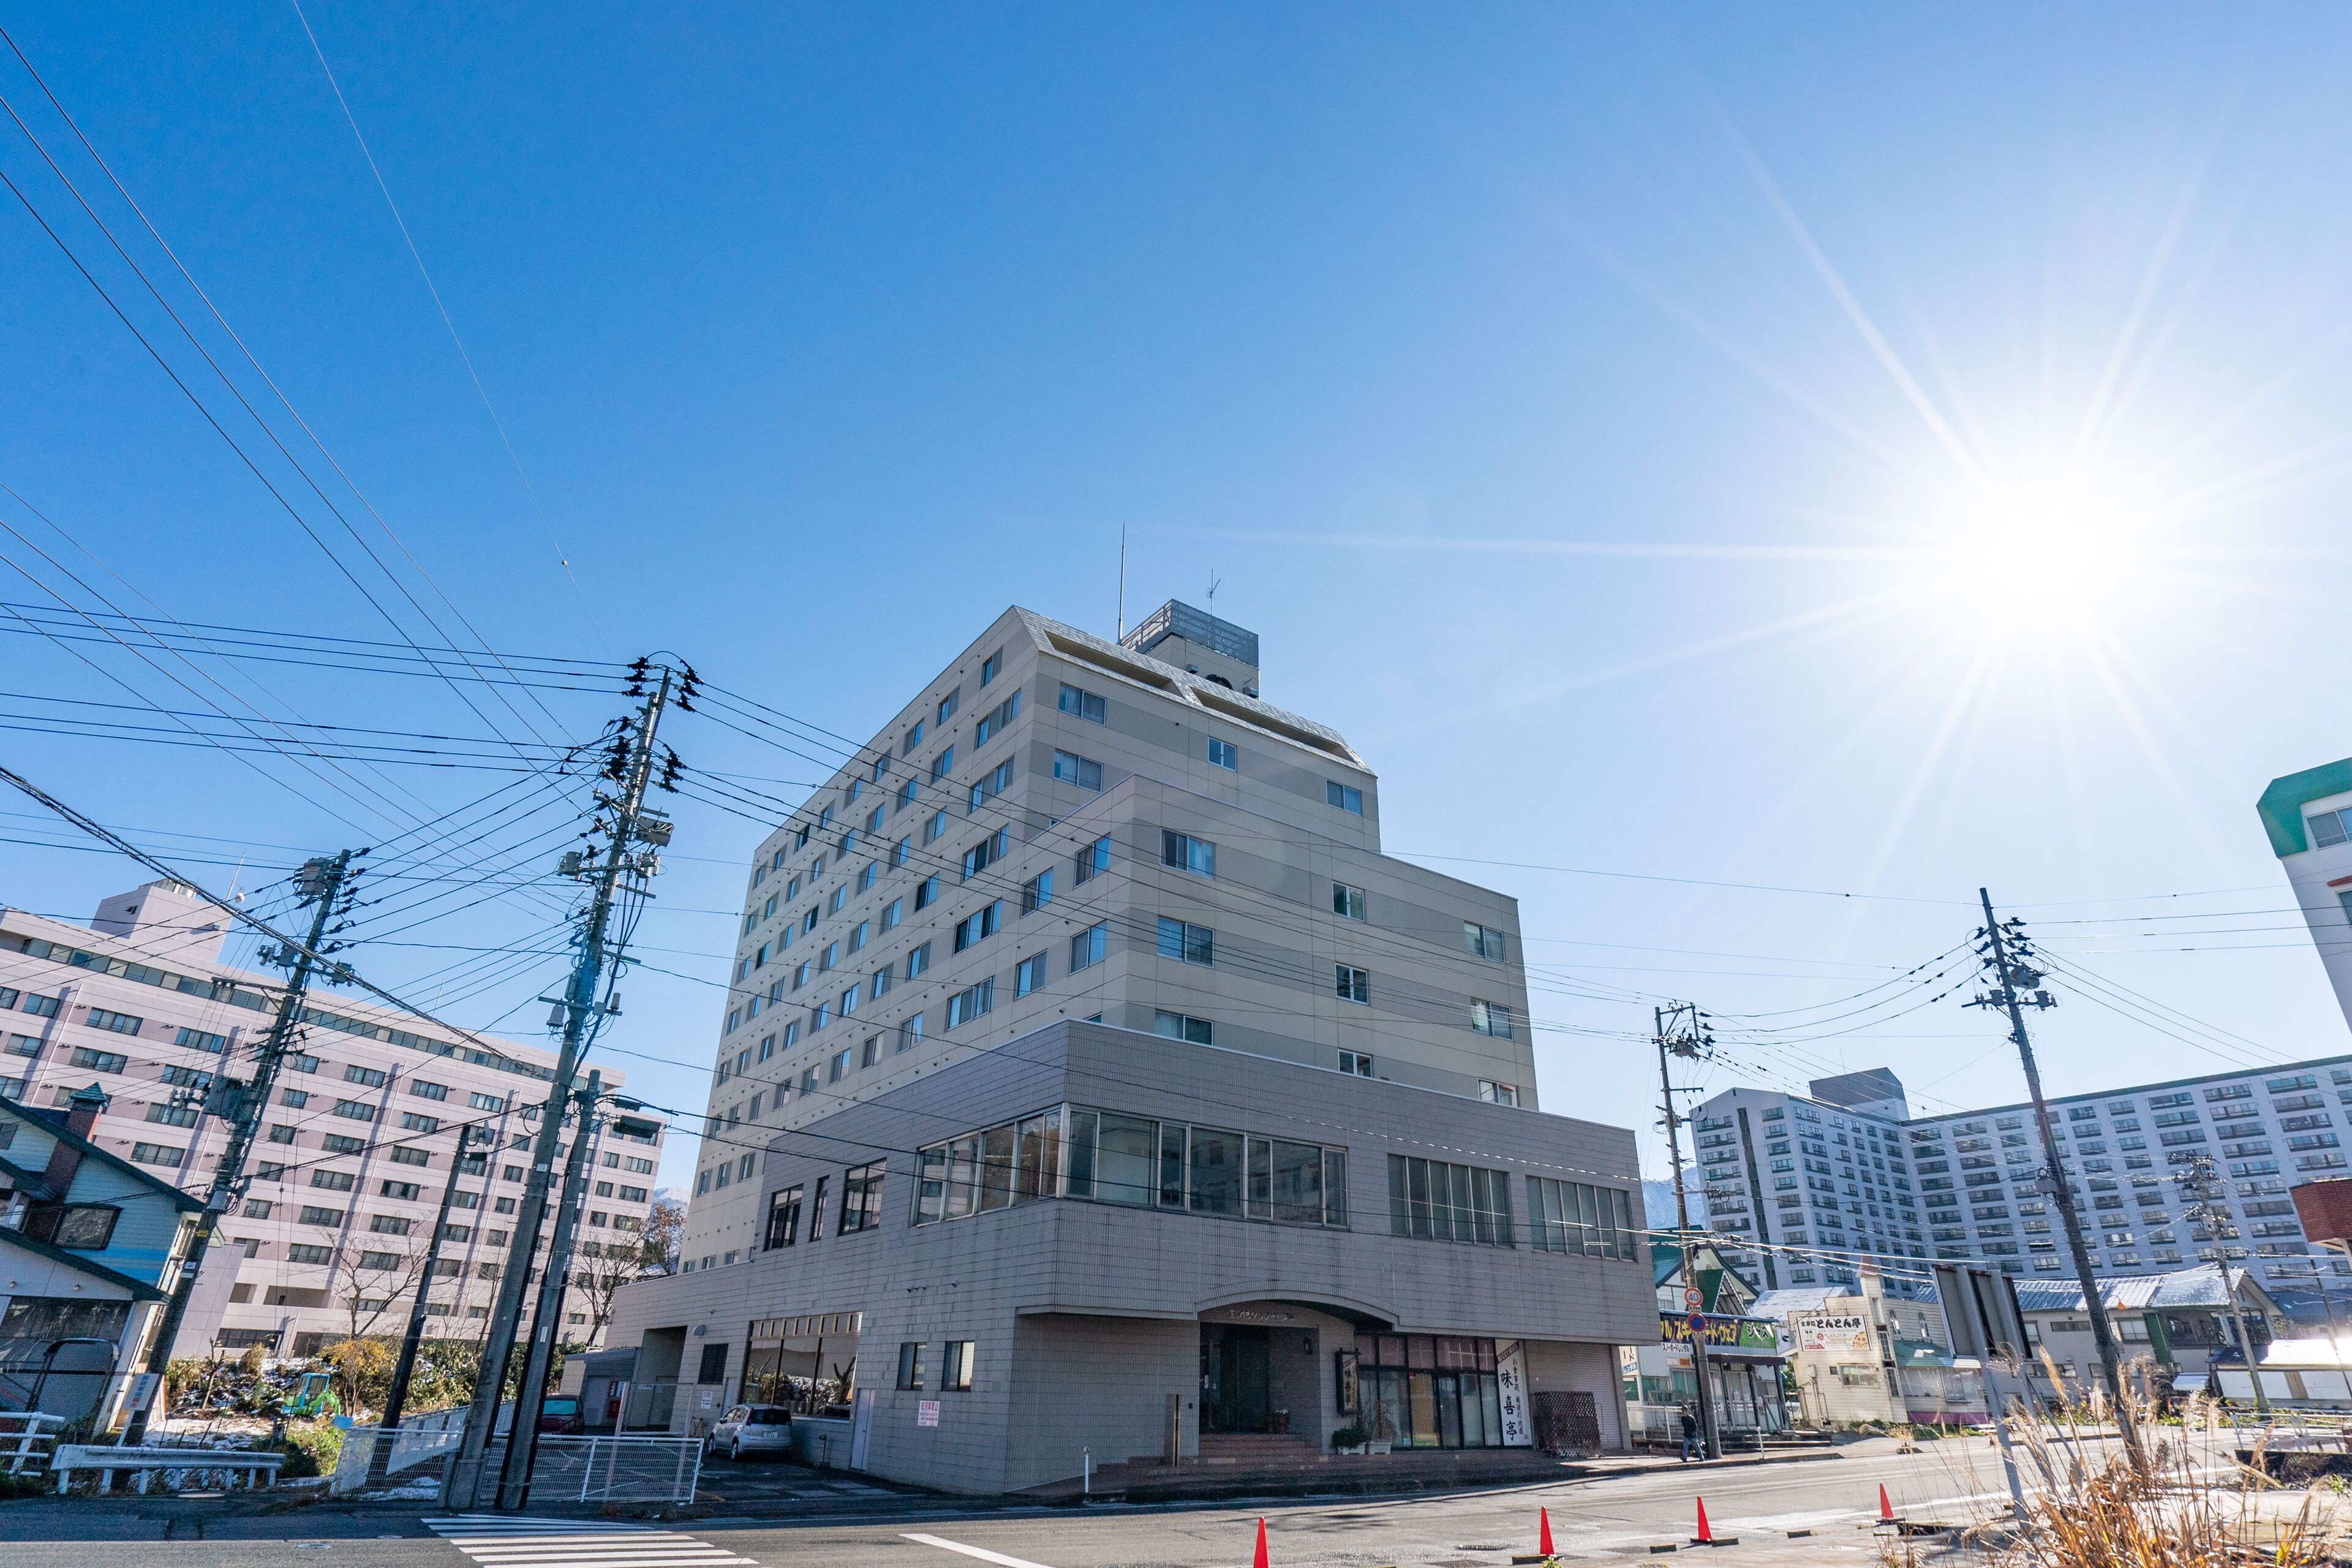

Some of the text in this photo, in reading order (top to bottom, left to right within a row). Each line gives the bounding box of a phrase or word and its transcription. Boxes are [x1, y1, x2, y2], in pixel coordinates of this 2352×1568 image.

[1689, 1292, 1699, 1301] 40
[1815, 1317, 1861, 1329] とんとん亭
[1501, 1369, 1517, 1441] 味喜亭
